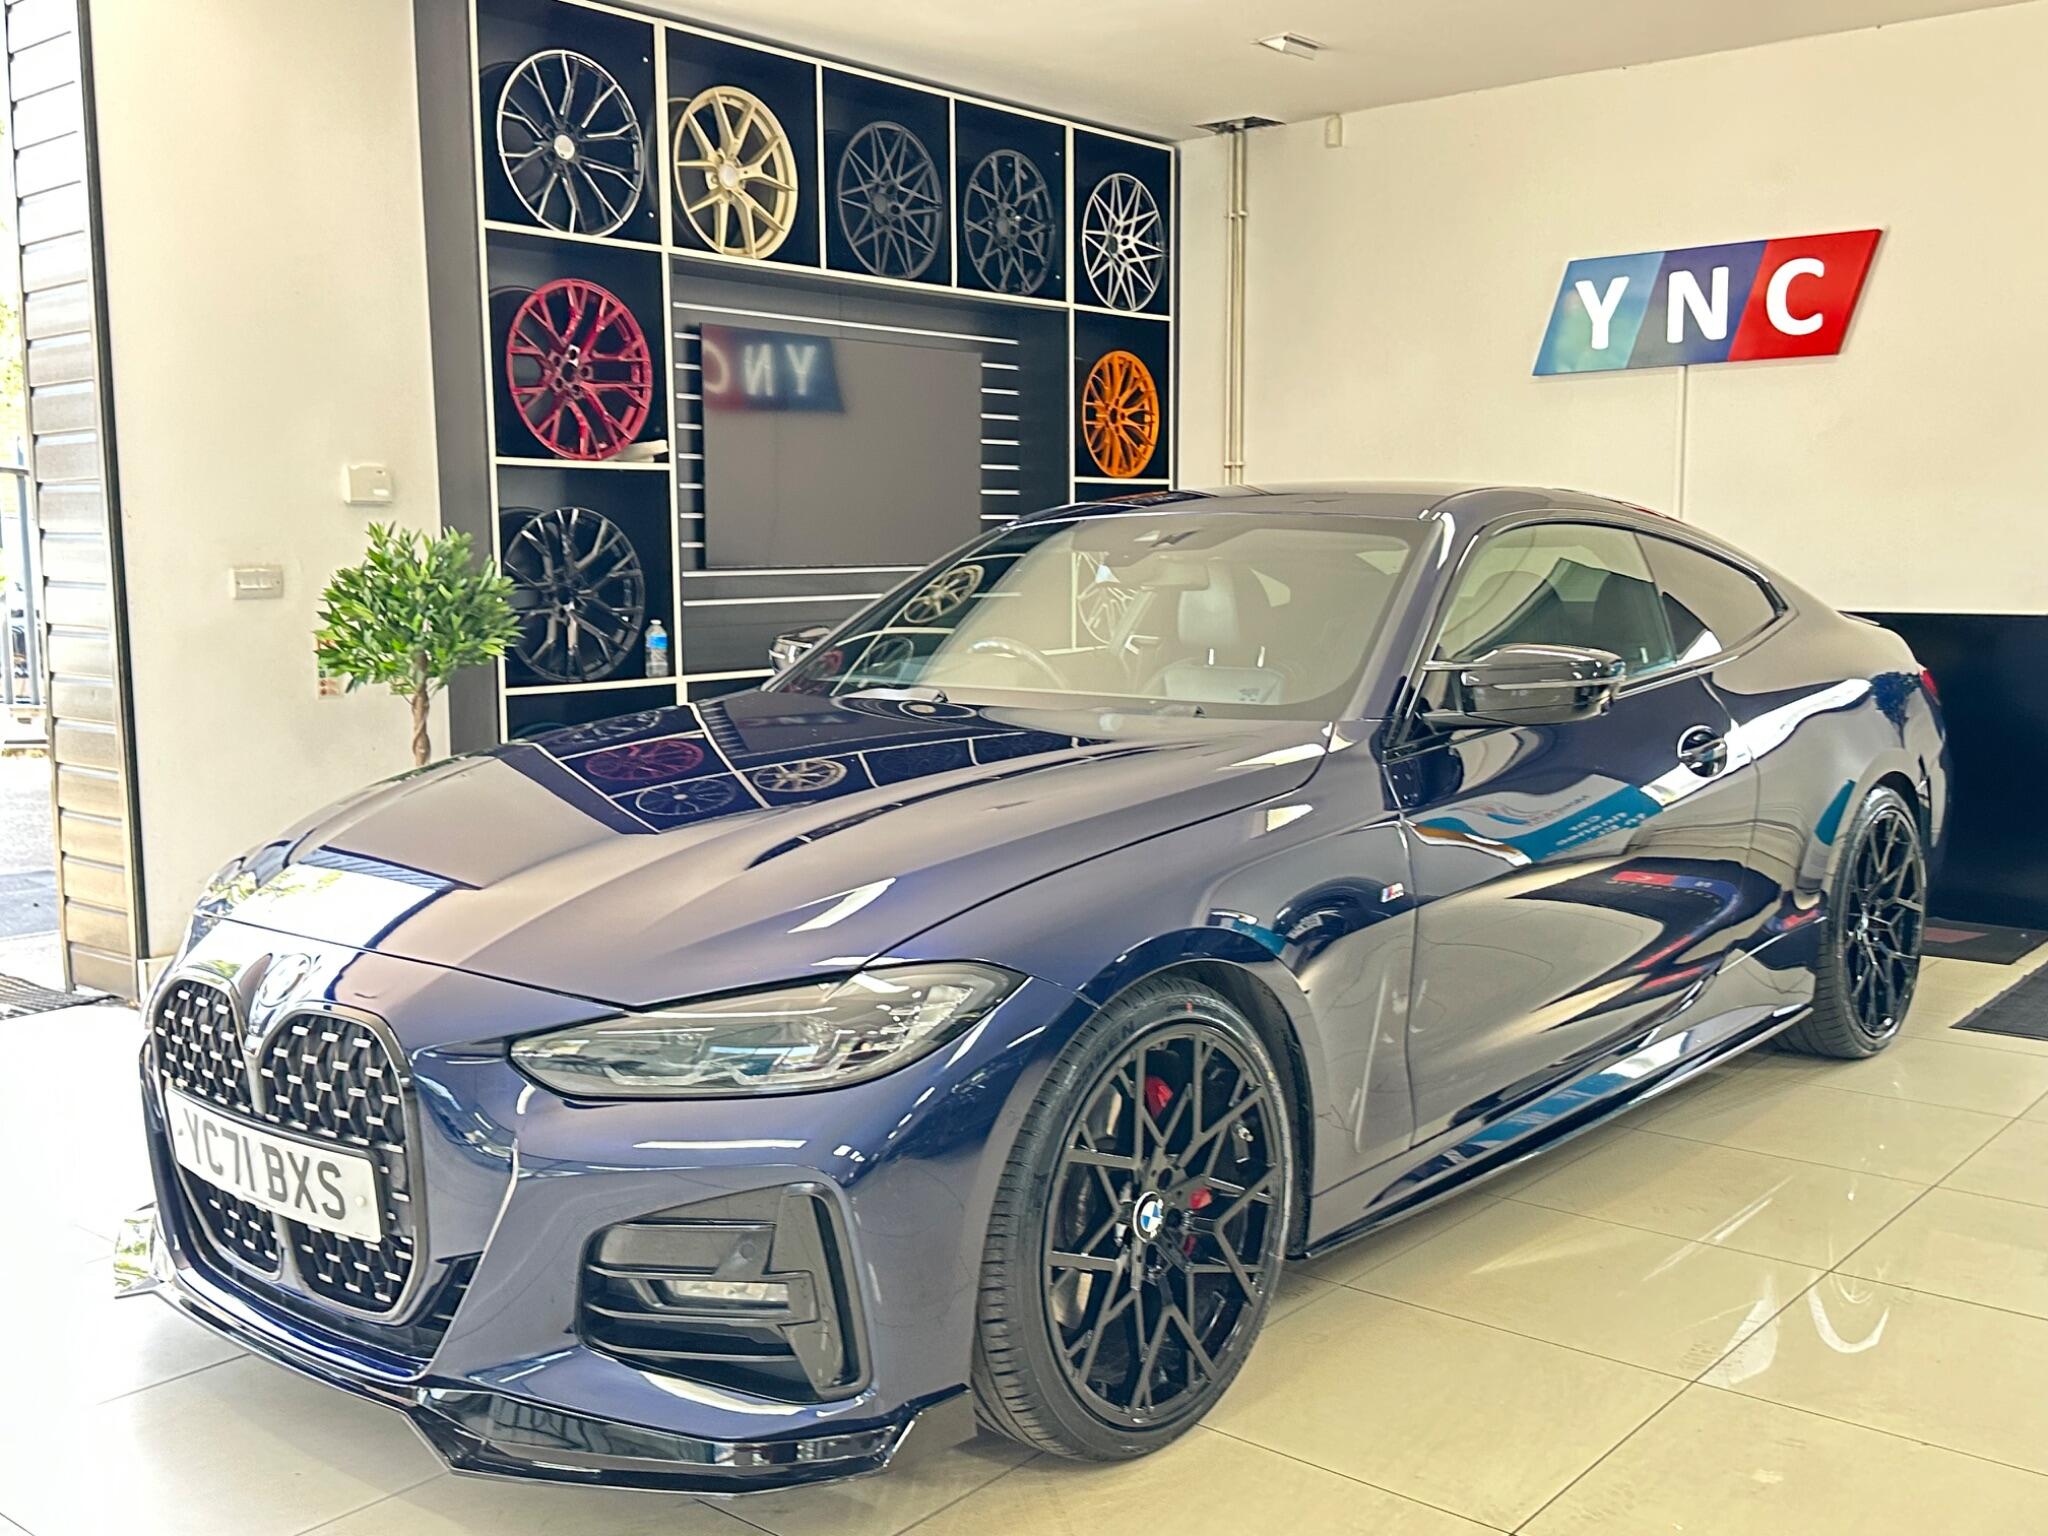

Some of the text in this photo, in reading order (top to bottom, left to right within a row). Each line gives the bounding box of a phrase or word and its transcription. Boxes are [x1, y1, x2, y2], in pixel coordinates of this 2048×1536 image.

[1574, 257, 1826, 350] YNC
[183, 1107, 347, 1221] YC71 BXS
